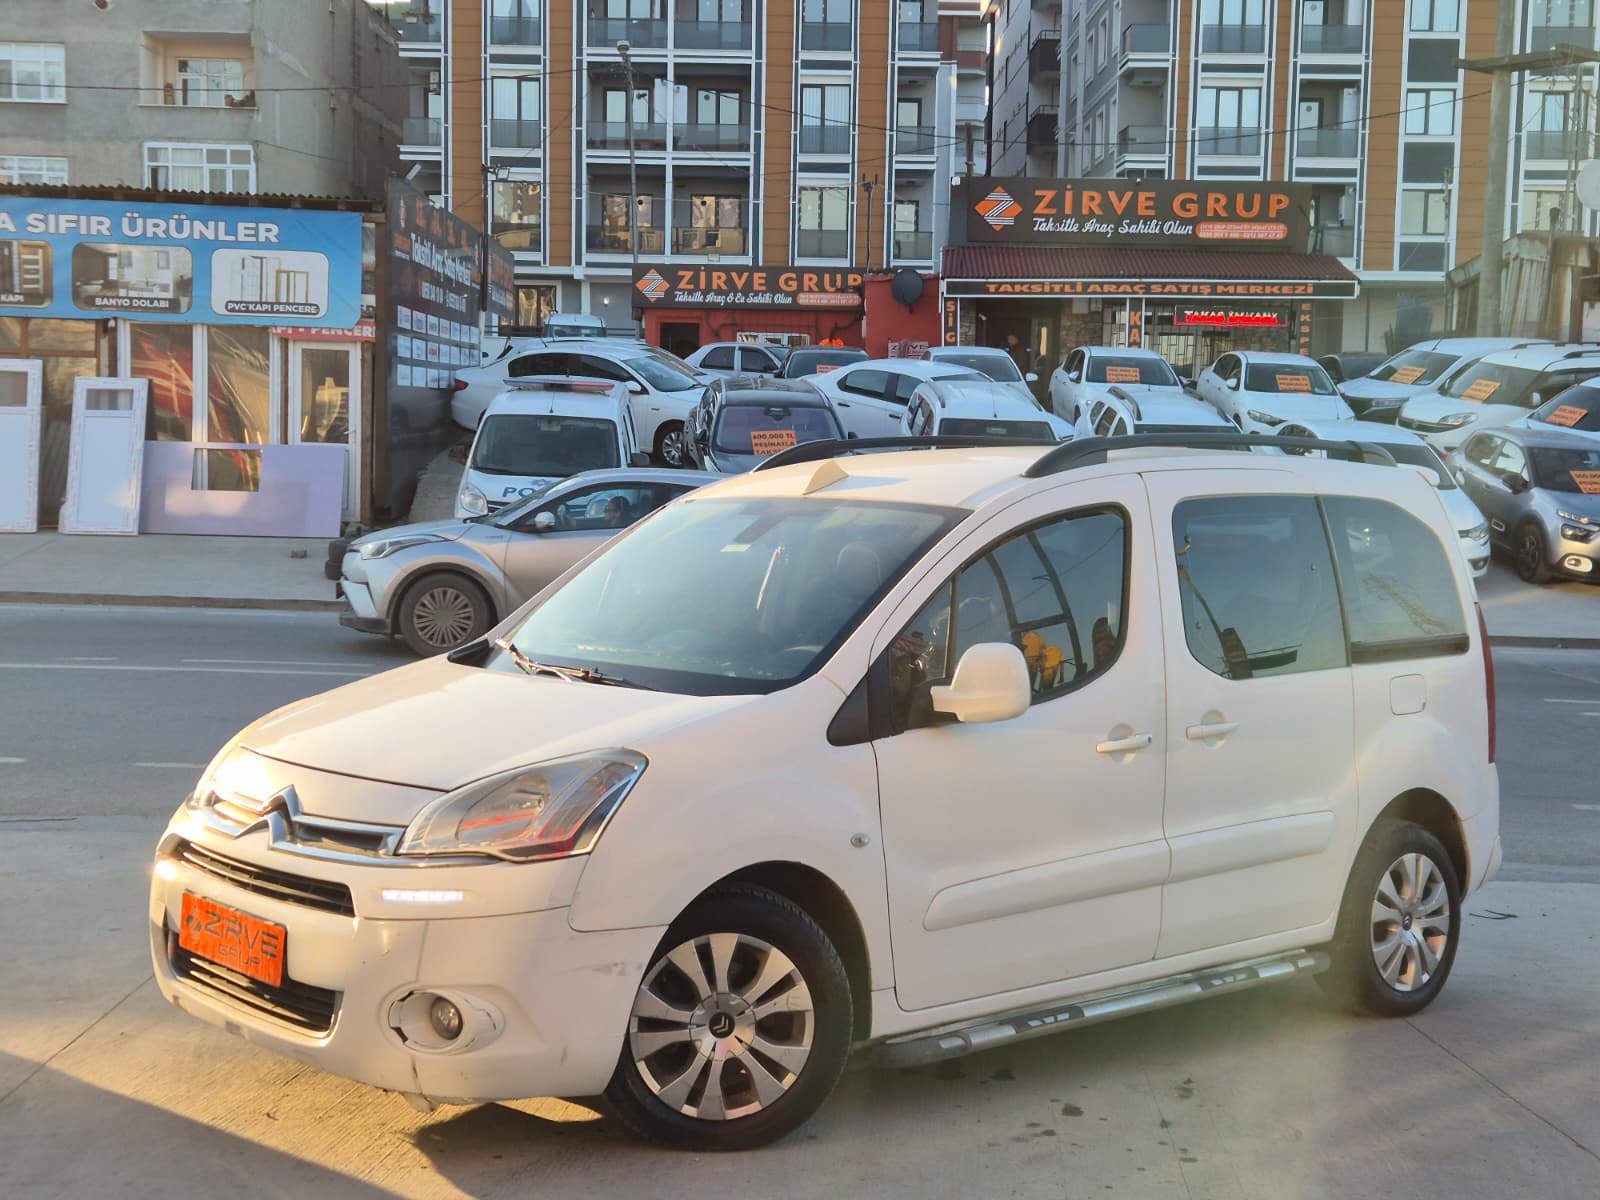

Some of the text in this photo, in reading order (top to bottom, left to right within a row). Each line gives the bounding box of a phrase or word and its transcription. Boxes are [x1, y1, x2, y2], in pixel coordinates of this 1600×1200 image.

[1033, 184, 1290, 218] ZİRVE GRUP
[26, 213, 112, 236] SIFIR
[121, 212, 280, 243] ÜRÜNLER
[1081, 218, 1114, 237] Araç
[1118, 219, 1160, 235] Sahibi
[1163, 221, 1193, 235] Olun
[677, 266, 863, 292] ZİRVE GRUP
[986, 281, 1314, 295] TAKSİTLİ ARAÇ SATIŞ MERKEZİ
[95, 297, 169, 308] BANYO DOLABI
[227, 302, 318, 314] PVC KAPI PENCERE
[945, 300, 956, 343] SİG
[1300, 303, 1311, 355] EKSPE
